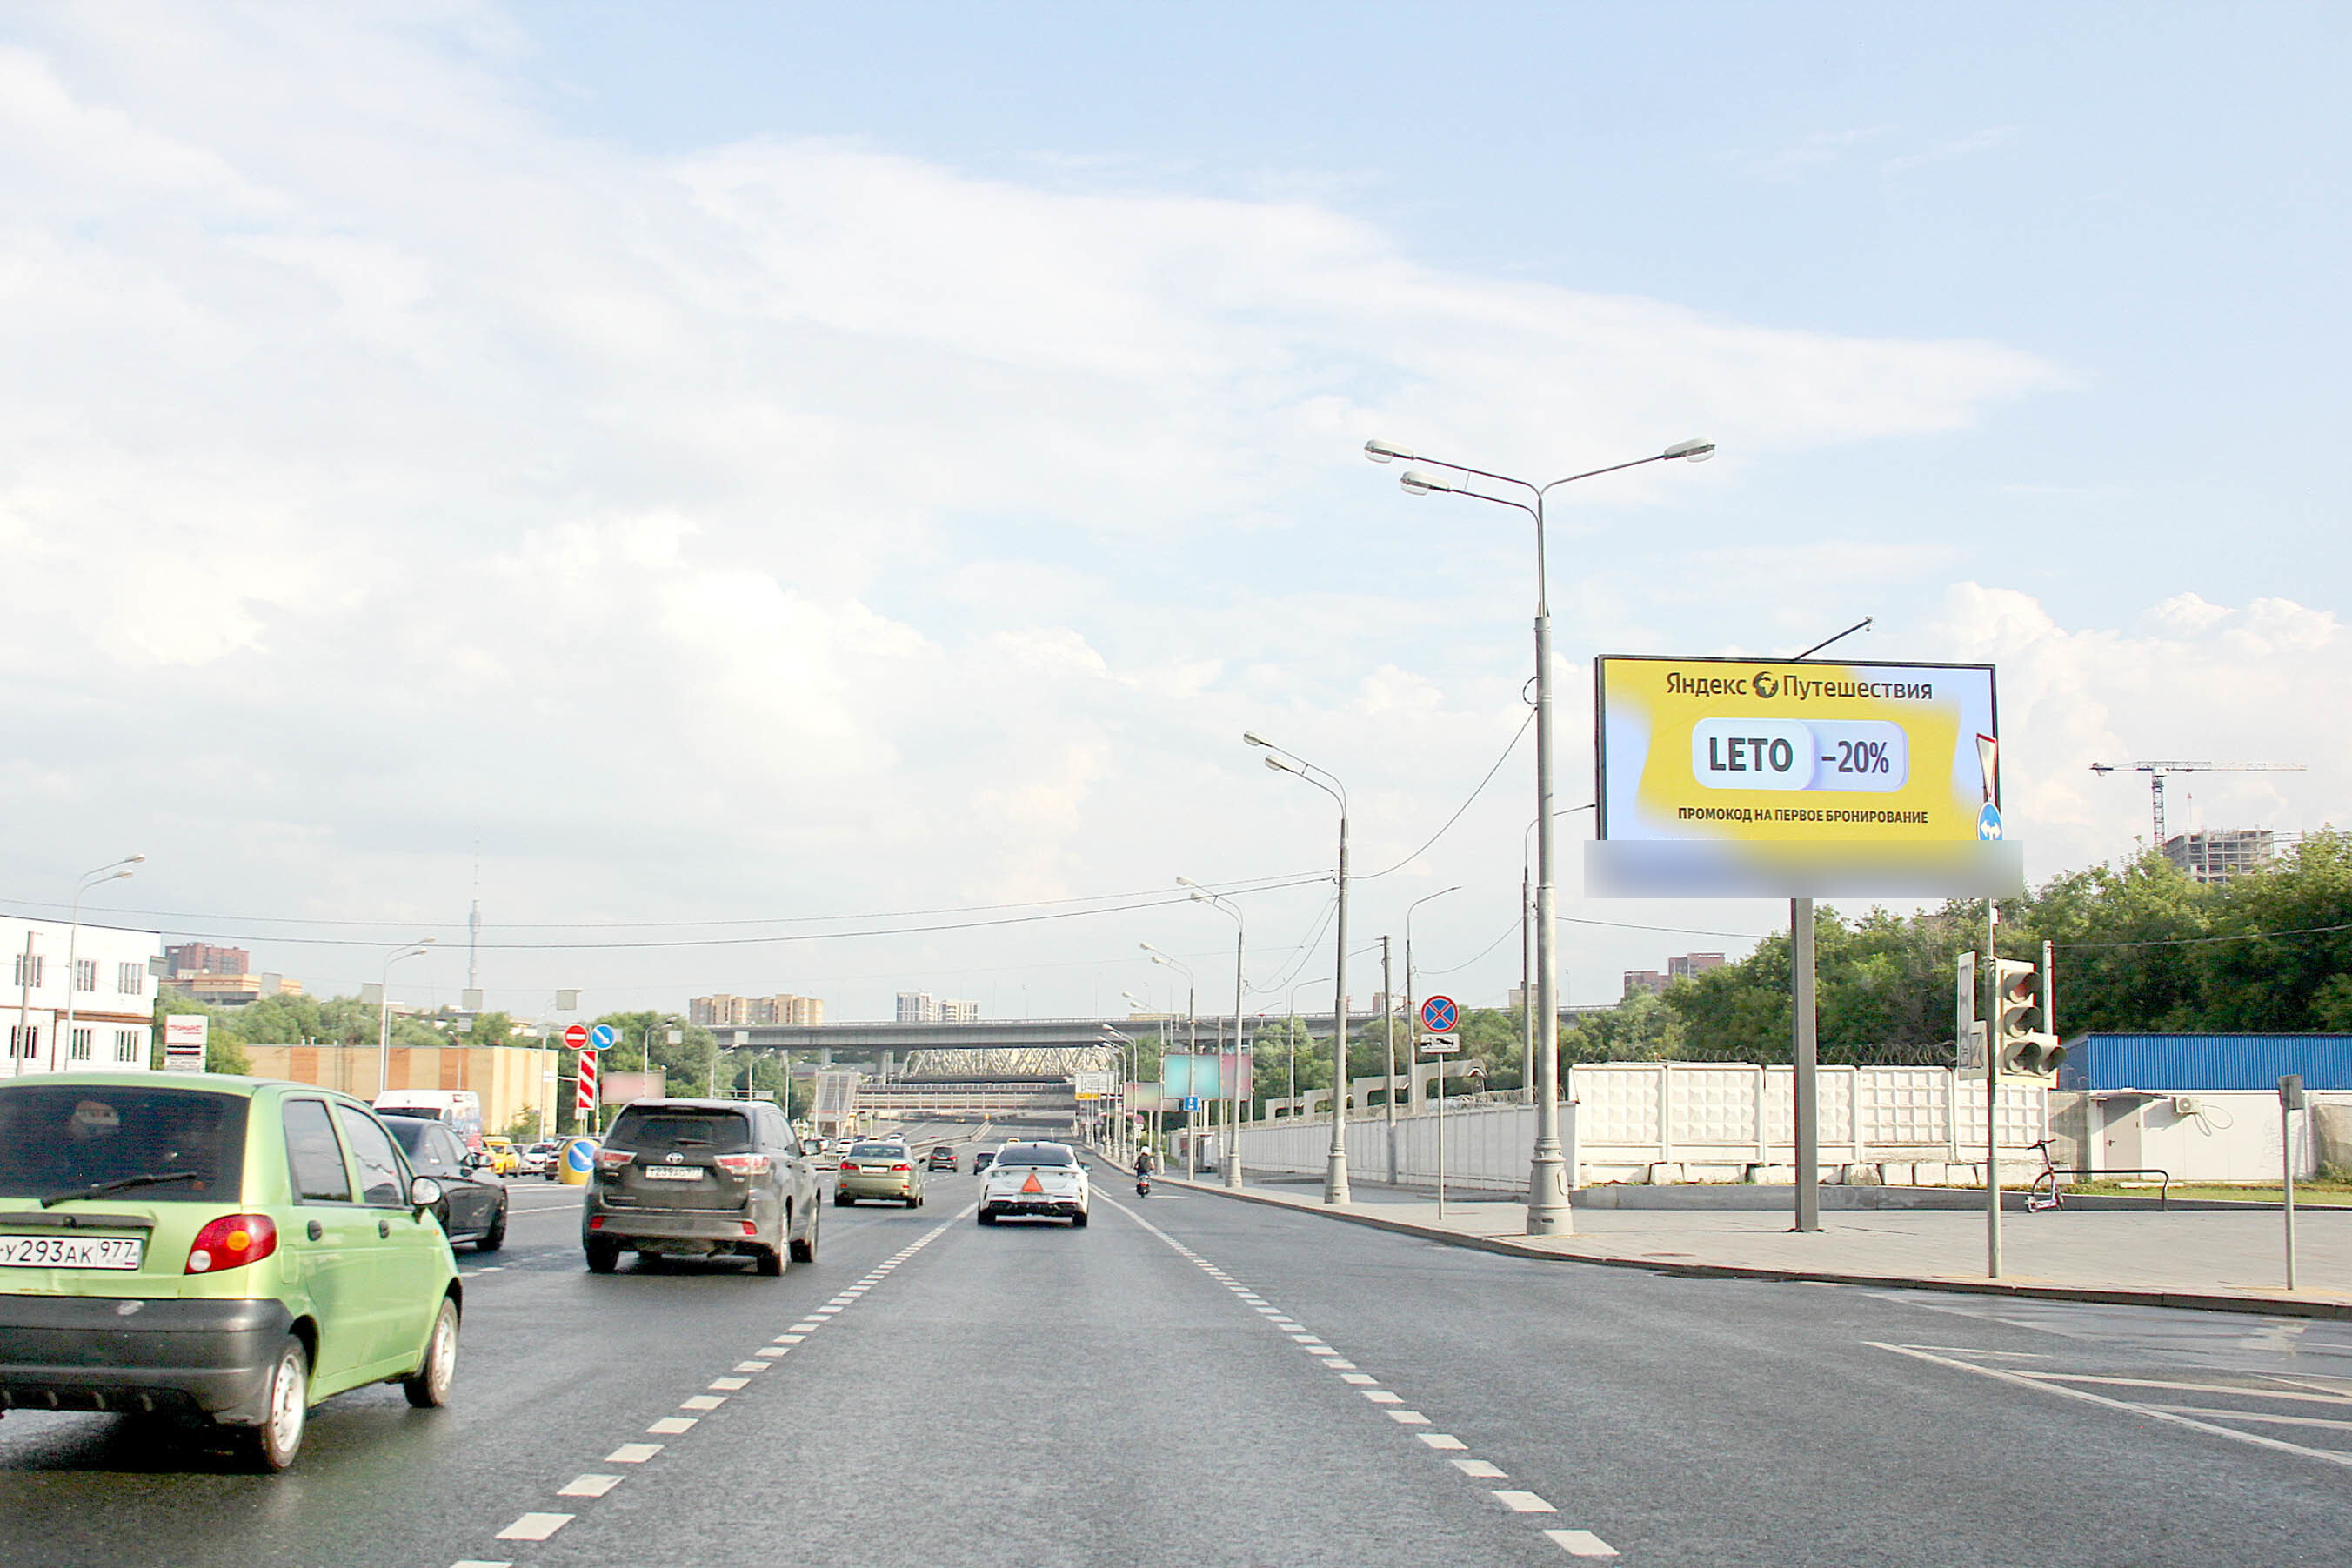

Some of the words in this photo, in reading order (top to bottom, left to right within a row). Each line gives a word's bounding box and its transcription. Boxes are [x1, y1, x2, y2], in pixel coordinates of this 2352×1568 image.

[1667, 671, 1747, 697] Яндекс
[1783, 674, 1933, 701] Путешествия
[1709, 737, 1794, 772] LETO
[1821, 740, 1890, 774] -20%
[1678, 806, 1753, 823] ПРОМОКОД
[1754, 808, 1773, 821] НА
[1774, 808, 1824, 822] ПЕРВОЕ
[1826, 809, 1928, 824] БРОНИРОВАНИЕ
